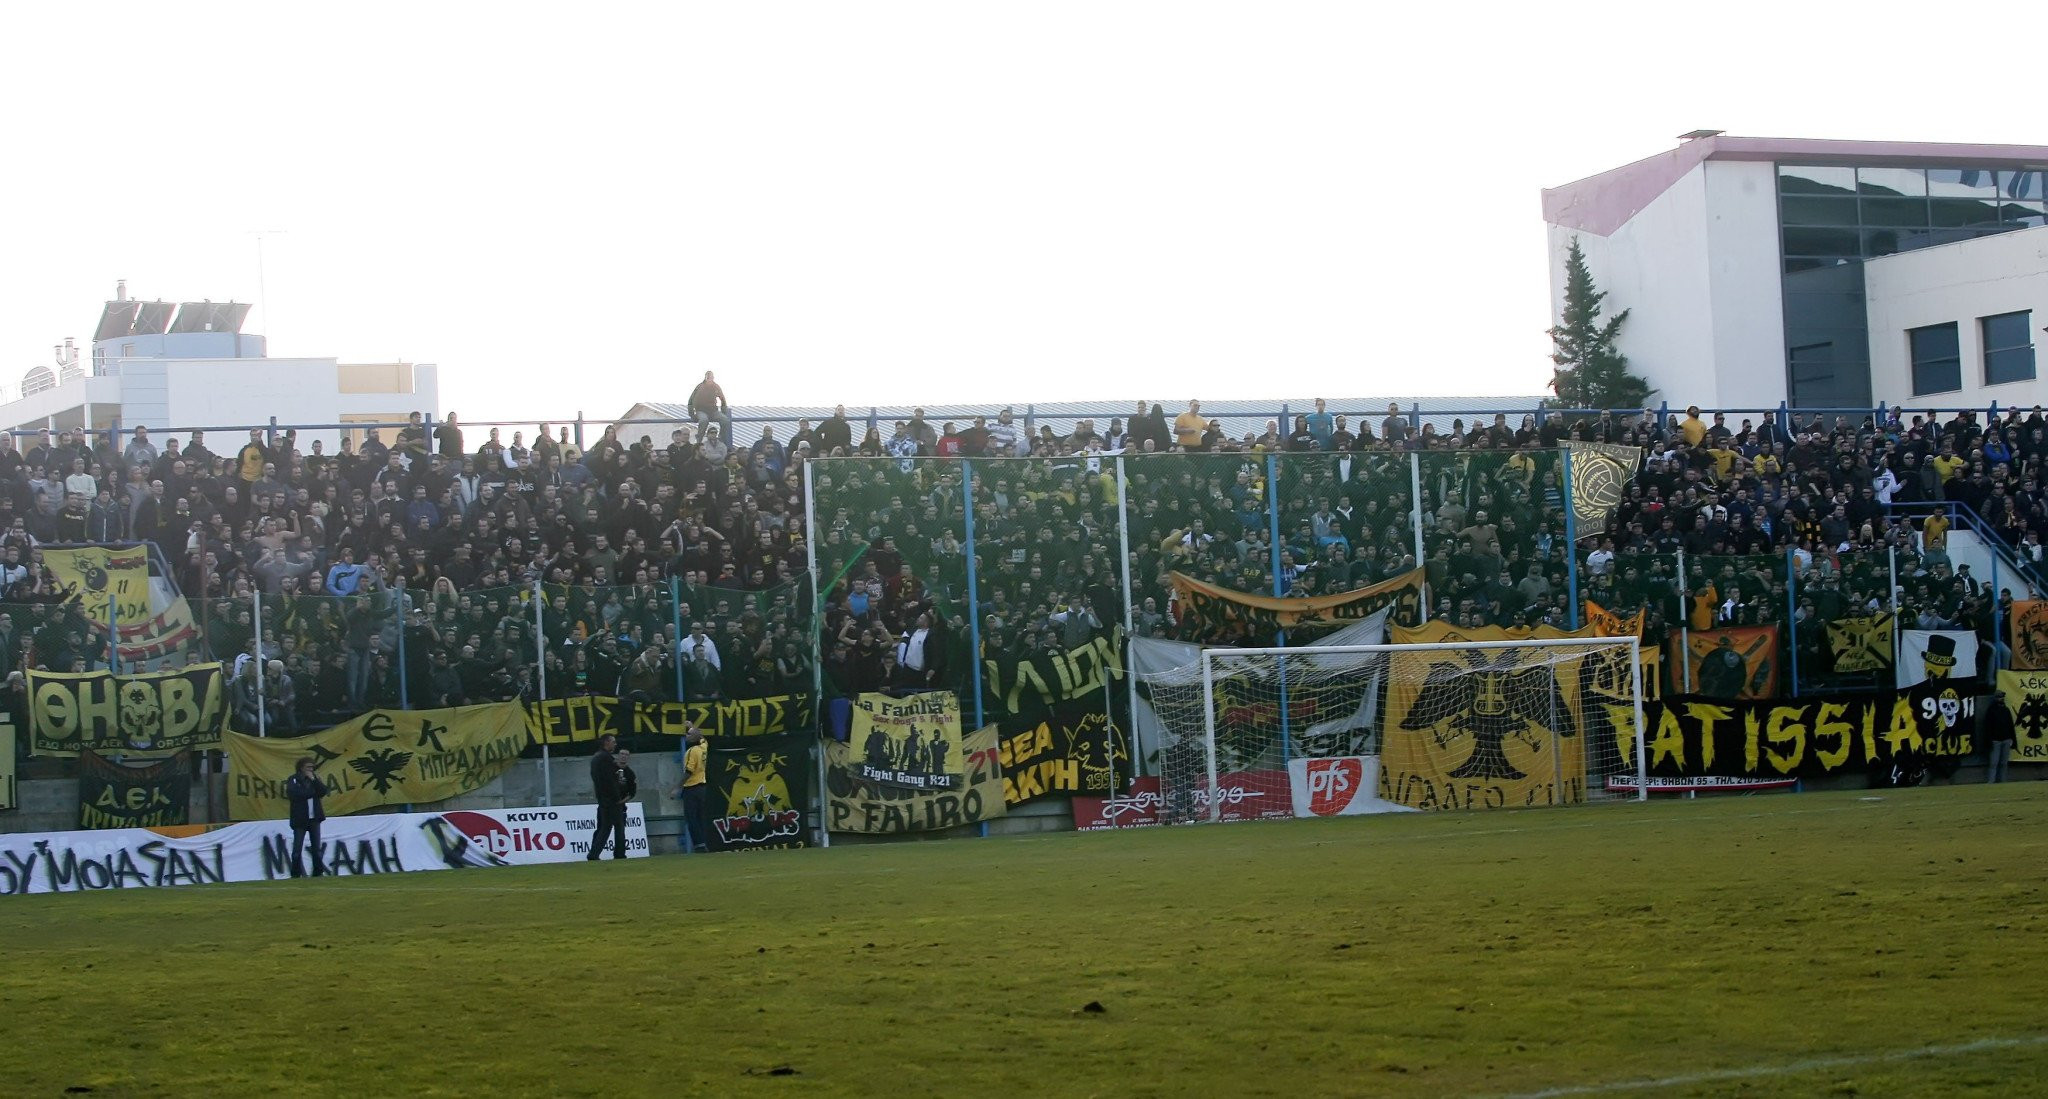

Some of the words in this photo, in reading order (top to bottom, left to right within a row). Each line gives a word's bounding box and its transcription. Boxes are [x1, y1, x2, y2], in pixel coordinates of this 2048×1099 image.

[523, 696, 618, 744] ΝΕΟΣ
[634, 695, 790, 737] ΚΟΣΜΟΣ
[1921, 697, 1937, 720] 9
[1601, 691, 1924, 774] PATISSIA
[1924, 734, 1974, 756] CLUB
[863, 765, 893, 782] Fight
[897, 772, 925, 787] Gang
[1003, 759, 1079, 804] ΑΚΡΗ
[1308, 760, 1350, 800] pfs
[1661, 776, 1695, 786] ΘΗΒΩΝ
[1696, 776, 1708, 785] 95
[861, 788, 982, 832] FALIRO
[473, 828, 566, 854] abiko
